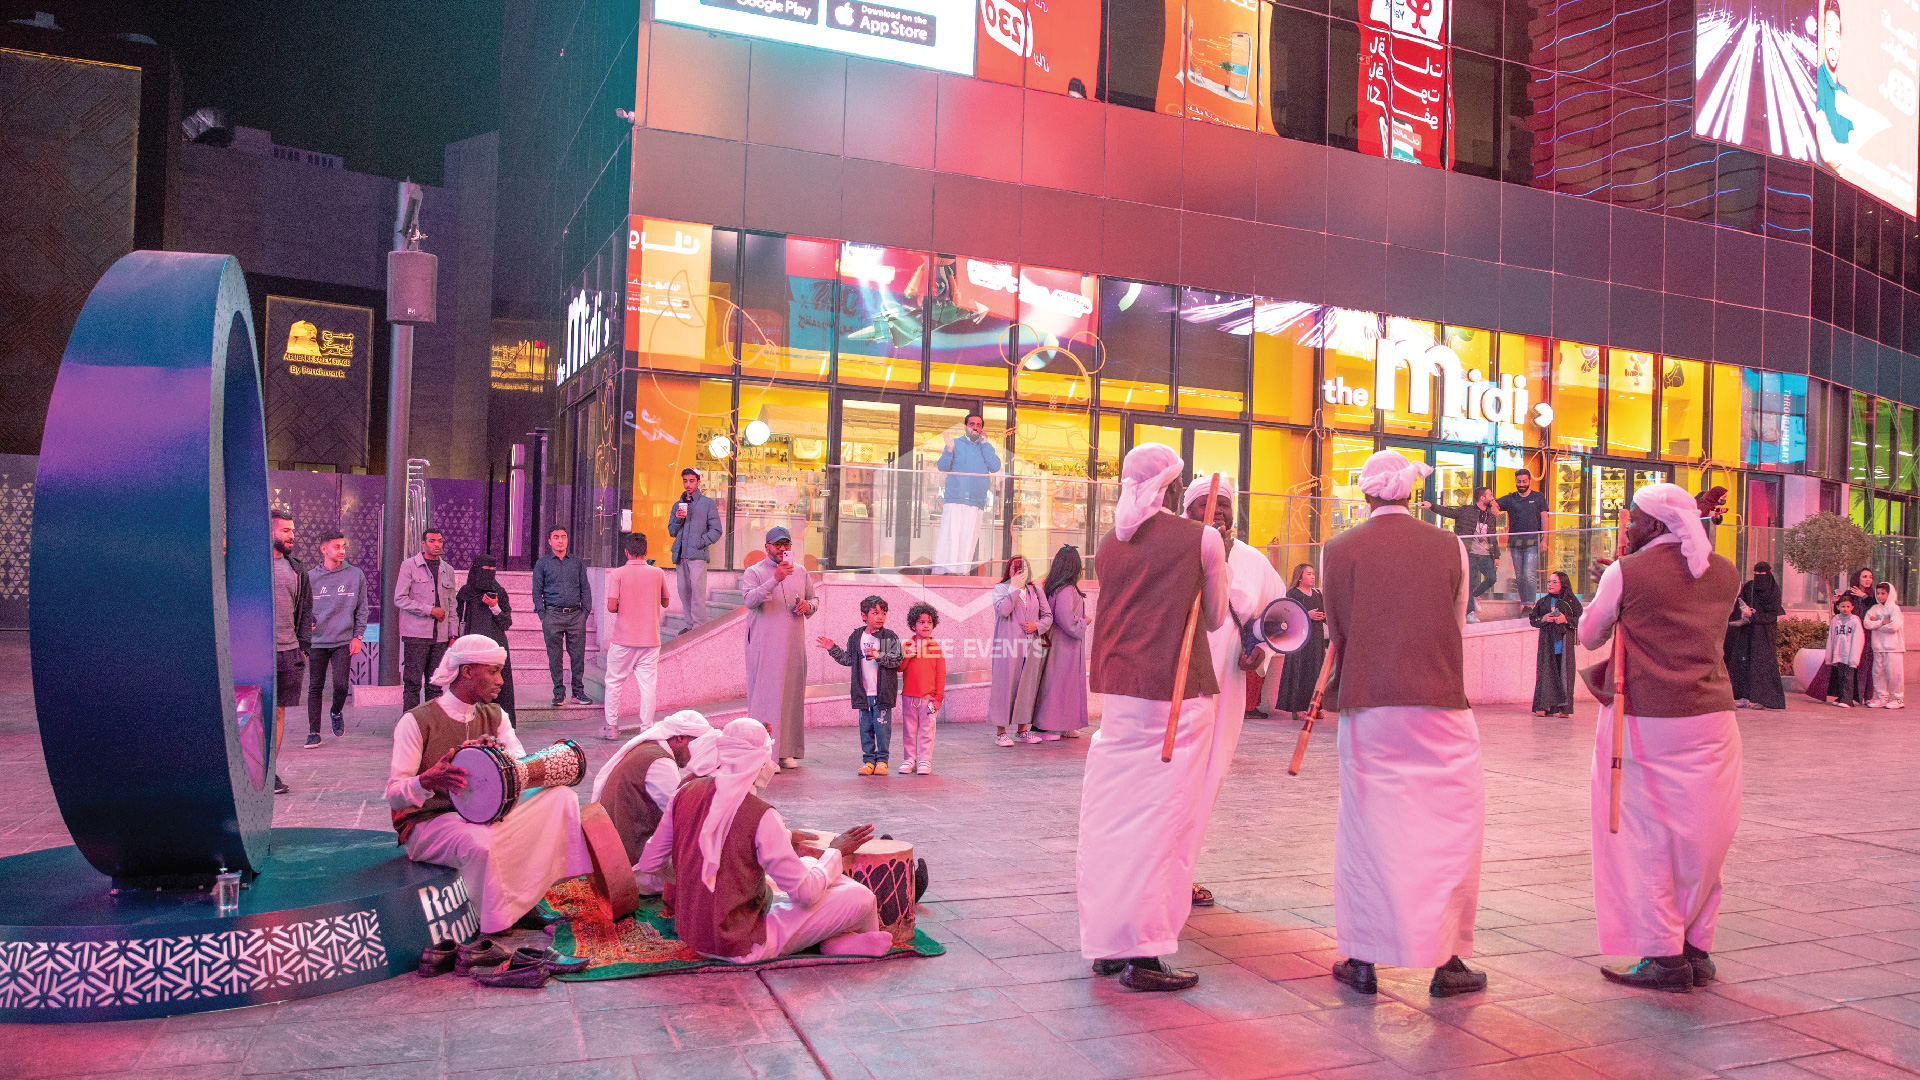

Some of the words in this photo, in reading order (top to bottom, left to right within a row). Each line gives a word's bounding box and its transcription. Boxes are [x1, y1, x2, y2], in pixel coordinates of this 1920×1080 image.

[785, 0, 812, 20] Play
[861, 4, 900, 22] Download
[902, 14, 913, 23] on
[914, 15, 928, 25] the
[859, 15, 889, 35] App
[889, 19, 928, 41] Store
[289, 364, 301, 375] By
[556, 357, 566, 387] the
[1322, 376, 1369, 407] the
[1782, 389, 1792, 431] THROUGH
